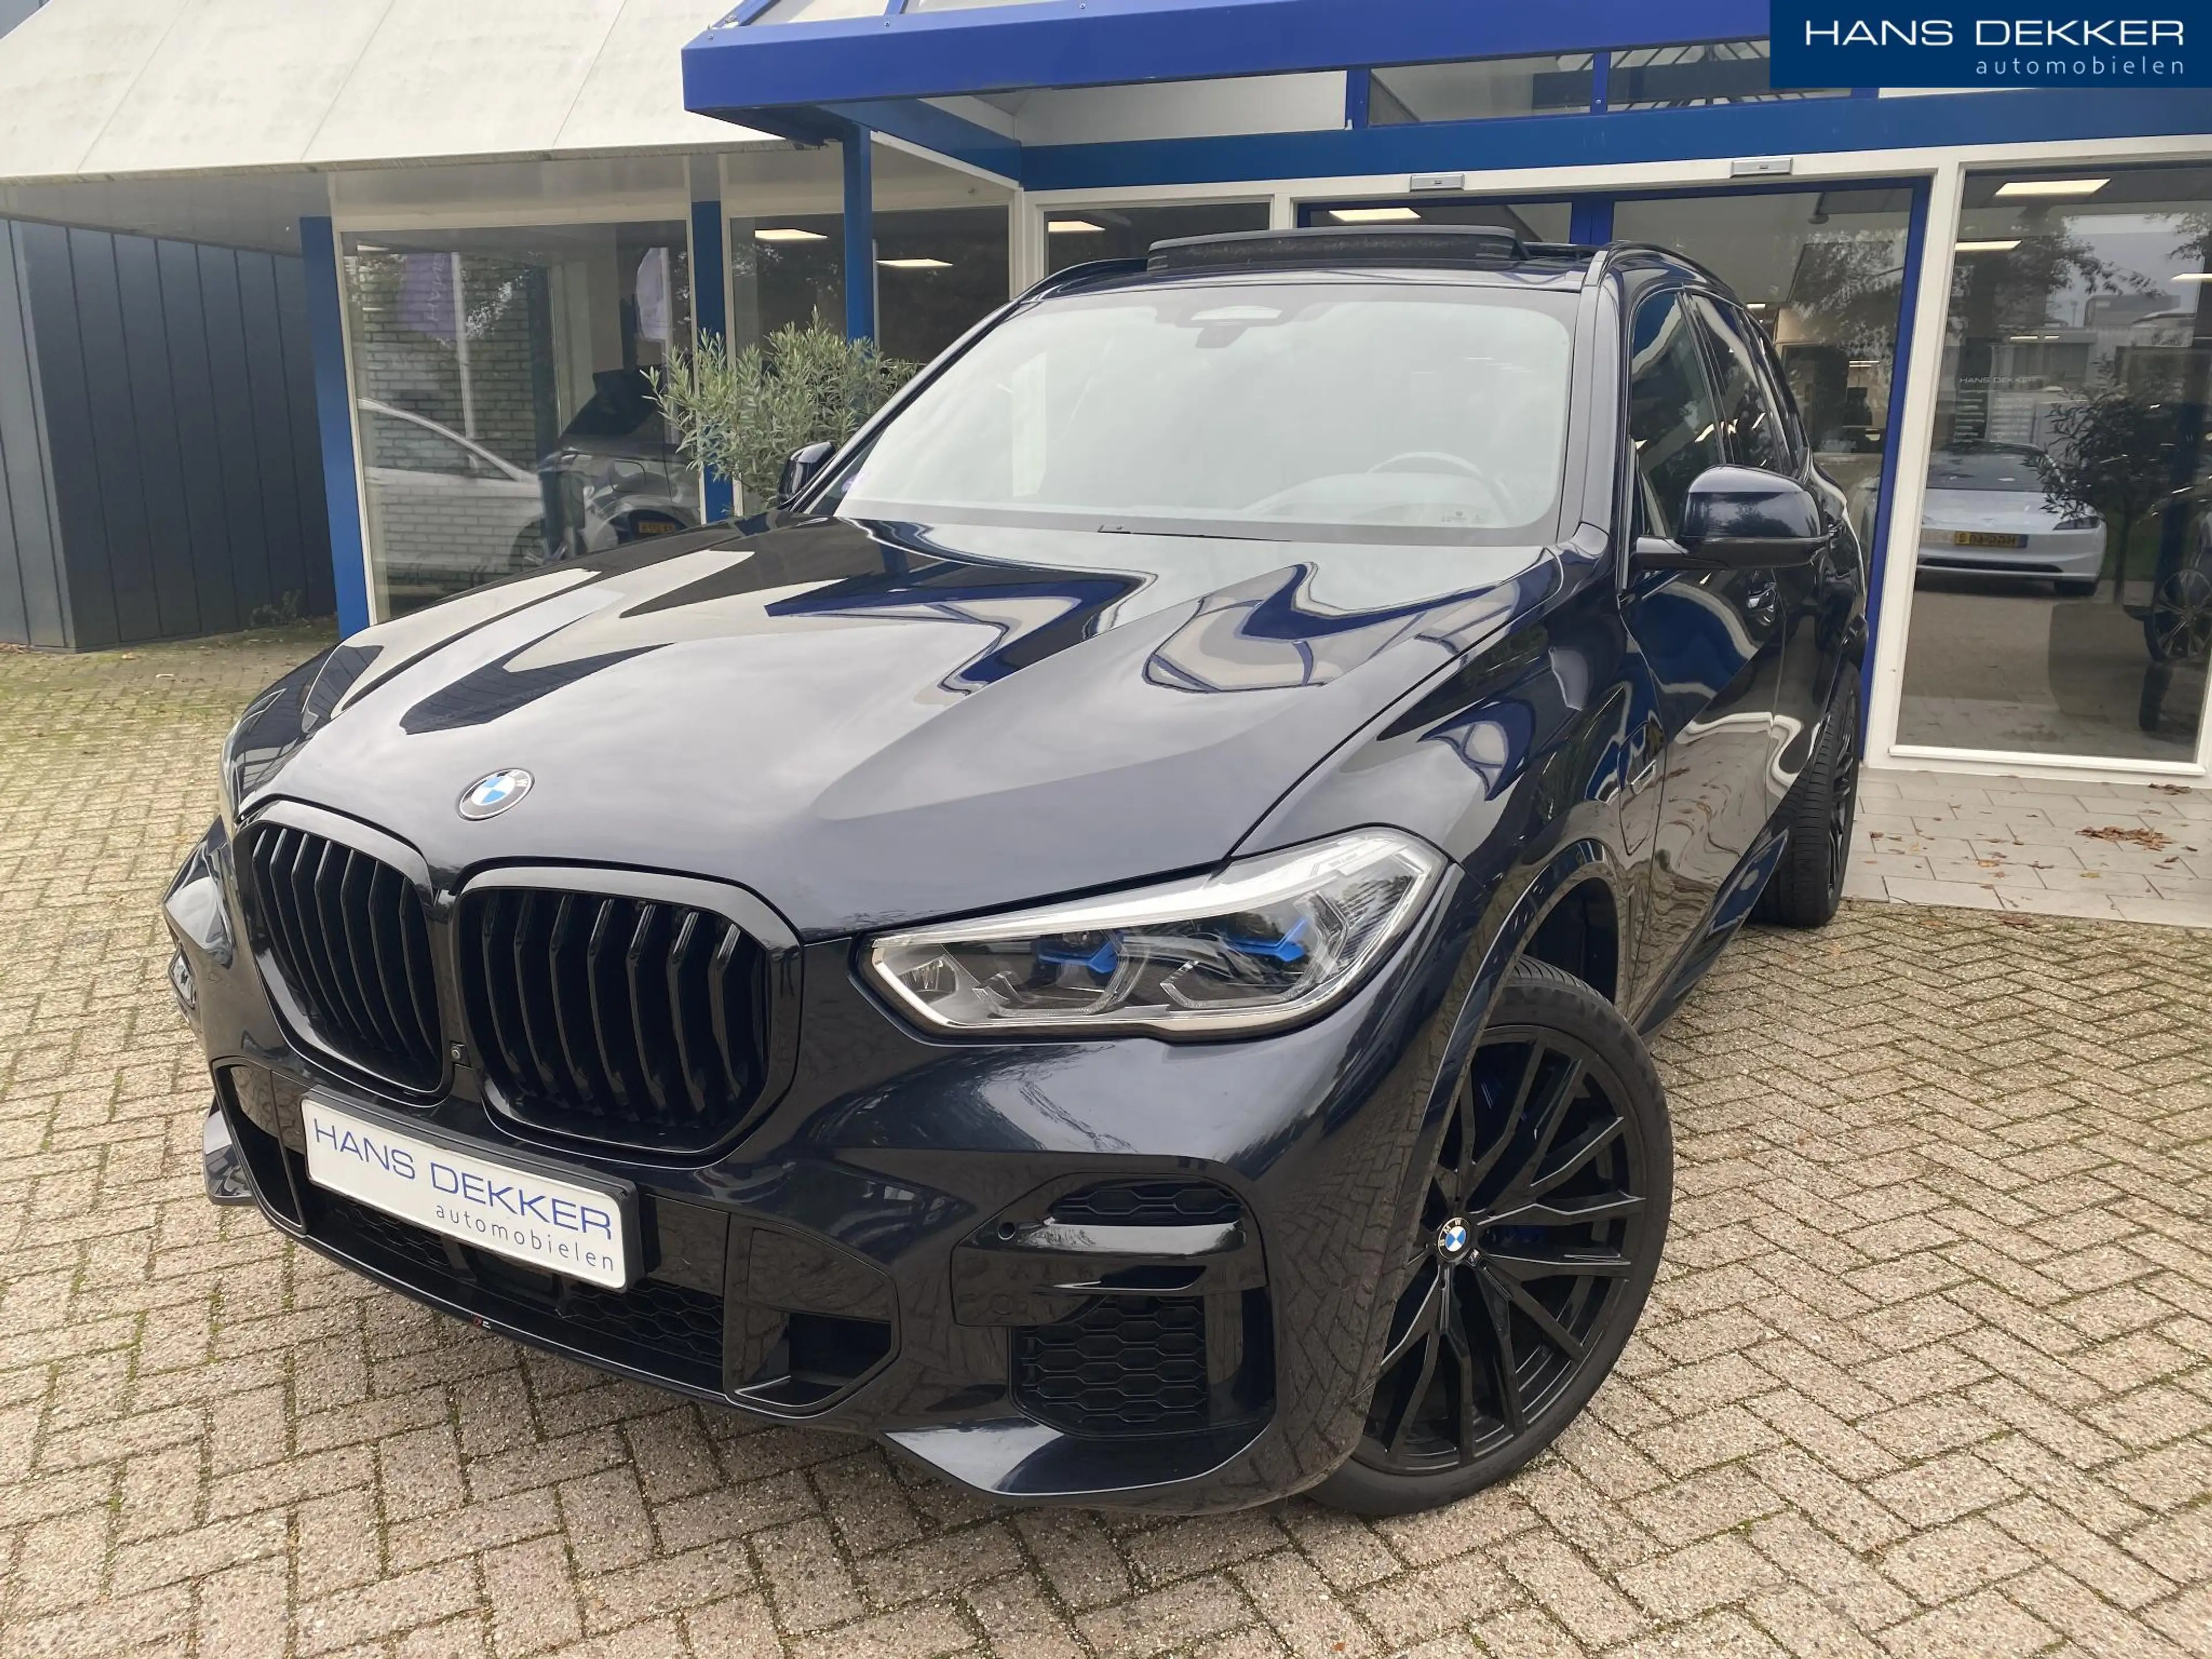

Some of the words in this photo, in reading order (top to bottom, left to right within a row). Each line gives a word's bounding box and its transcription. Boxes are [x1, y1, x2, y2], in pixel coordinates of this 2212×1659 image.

[313, 1118, 416, 1180] HANS
[430, 1161, 611, 1240] DEKKER
[435, 1203, 614, 1271] automobielen
